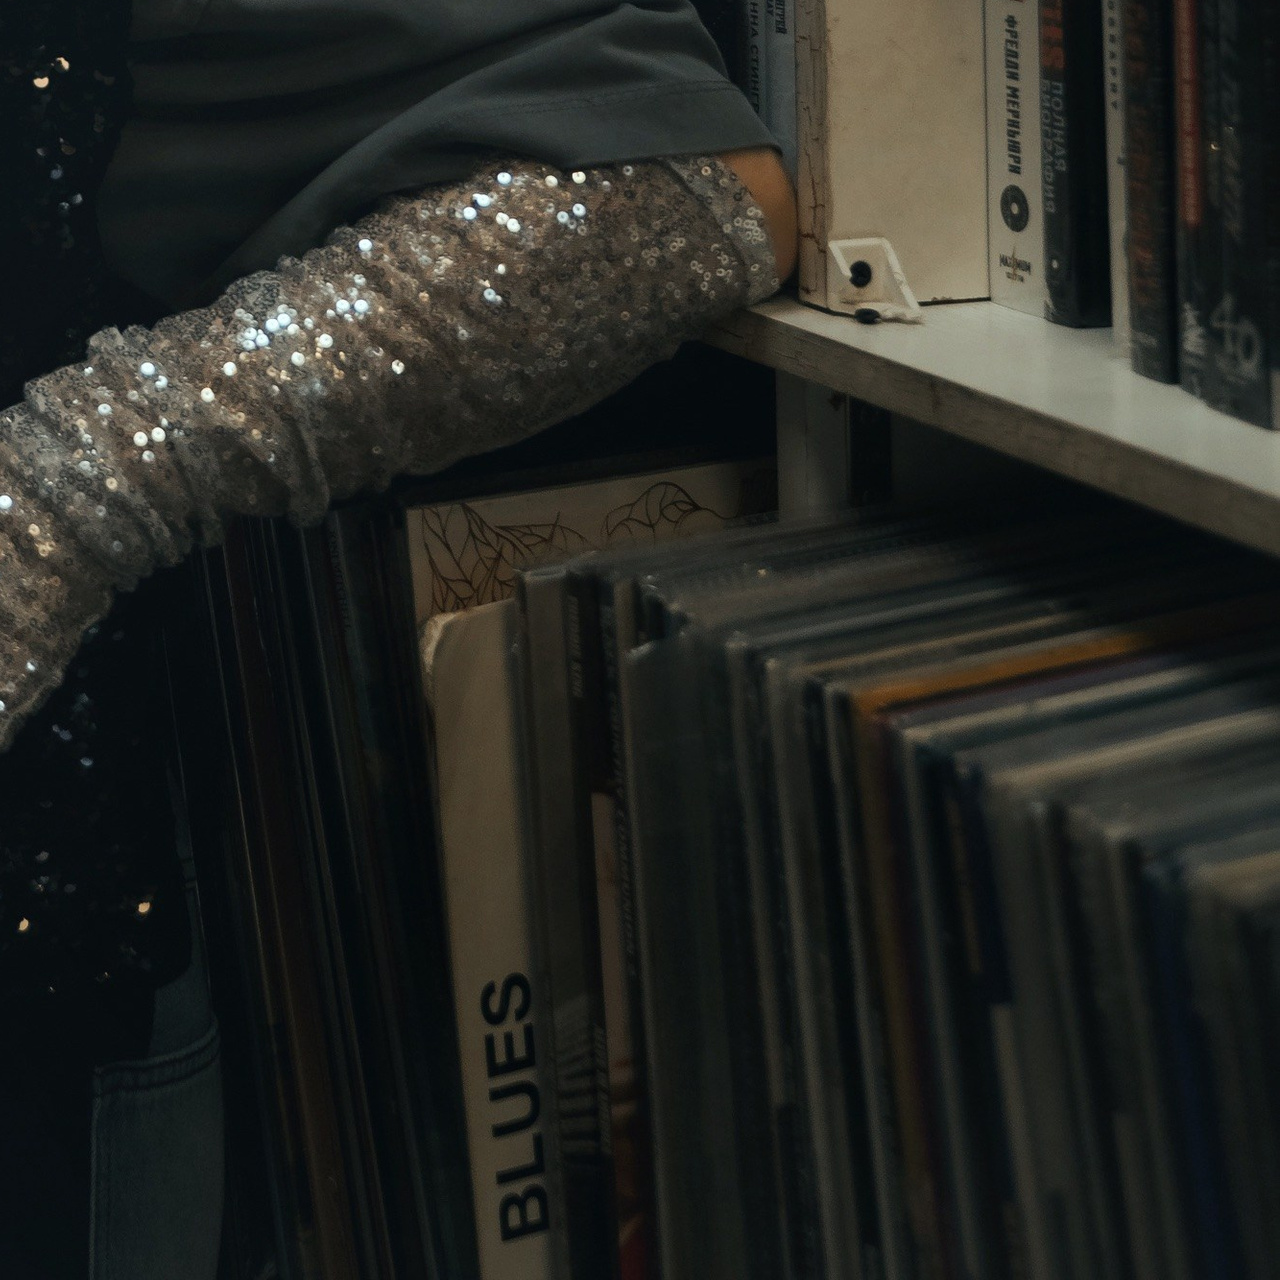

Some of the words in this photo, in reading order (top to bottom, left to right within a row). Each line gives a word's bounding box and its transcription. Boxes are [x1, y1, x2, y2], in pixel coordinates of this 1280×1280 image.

[1003, 14, 1020, 81] ФРЕДДИ
[1040, 78, 1058, 215] БИОГРАФИЯ
[1050, 78, 1067, 173] ПОЛНАЯ
[481, 970, 552, 1244] BLUES
